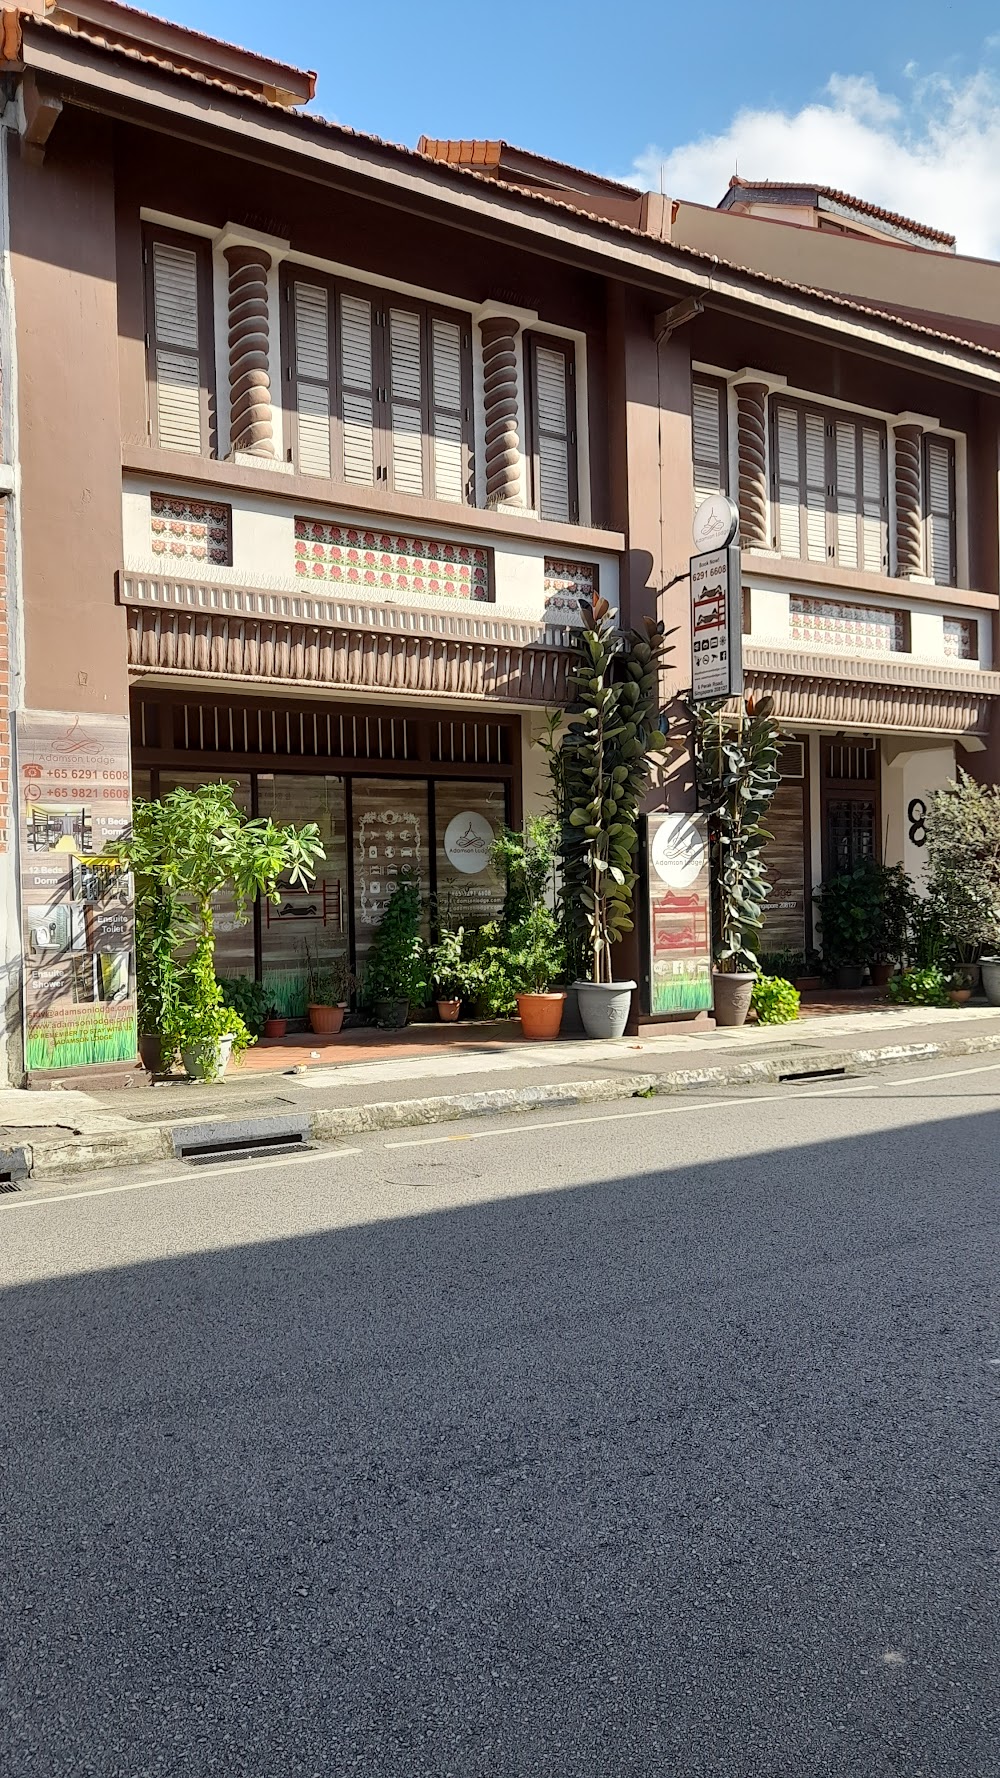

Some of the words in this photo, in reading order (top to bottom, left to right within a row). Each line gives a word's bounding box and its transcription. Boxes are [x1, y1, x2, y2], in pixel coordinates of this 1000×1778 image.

[692, 570, 708, 581] 6291
[710, 564, 727, 577] 6608
[38, 754, 85, 763] Adamson
[86, 755, 116, 765] Lodge
[47, 769, 68, 779] +65
[71, 769, 98, 780] 6291
[102, 770, 129, 781] 6608
[47, 788, 68, 798] +65
[71, 788, 98, 798] 9821
[102, 789, 129, 799] 6608
[108, 817, 129, 826] Beds
[907, 798, 928, 848] 8
[101, 827, 125, 836] Dorm
[29, 866, 39, 874] 12
[40, 866, 64, 874] Beds
[34, 876, 59, 885] Dorm
[779, 901, 797, 909] 208127
[97, 915, 129, 923] Ensuite
[102, 925, 124, 933] Toilet
[32, 970, 65, 978] Ensuite
[32, 980, 65, 989] Shower
[28, 1016, 134, 1030] www.adamsonlodge.com
[41, 1030, 78, 1039] REMEMBER
[90, 1034, 114, 1042] LODGE
